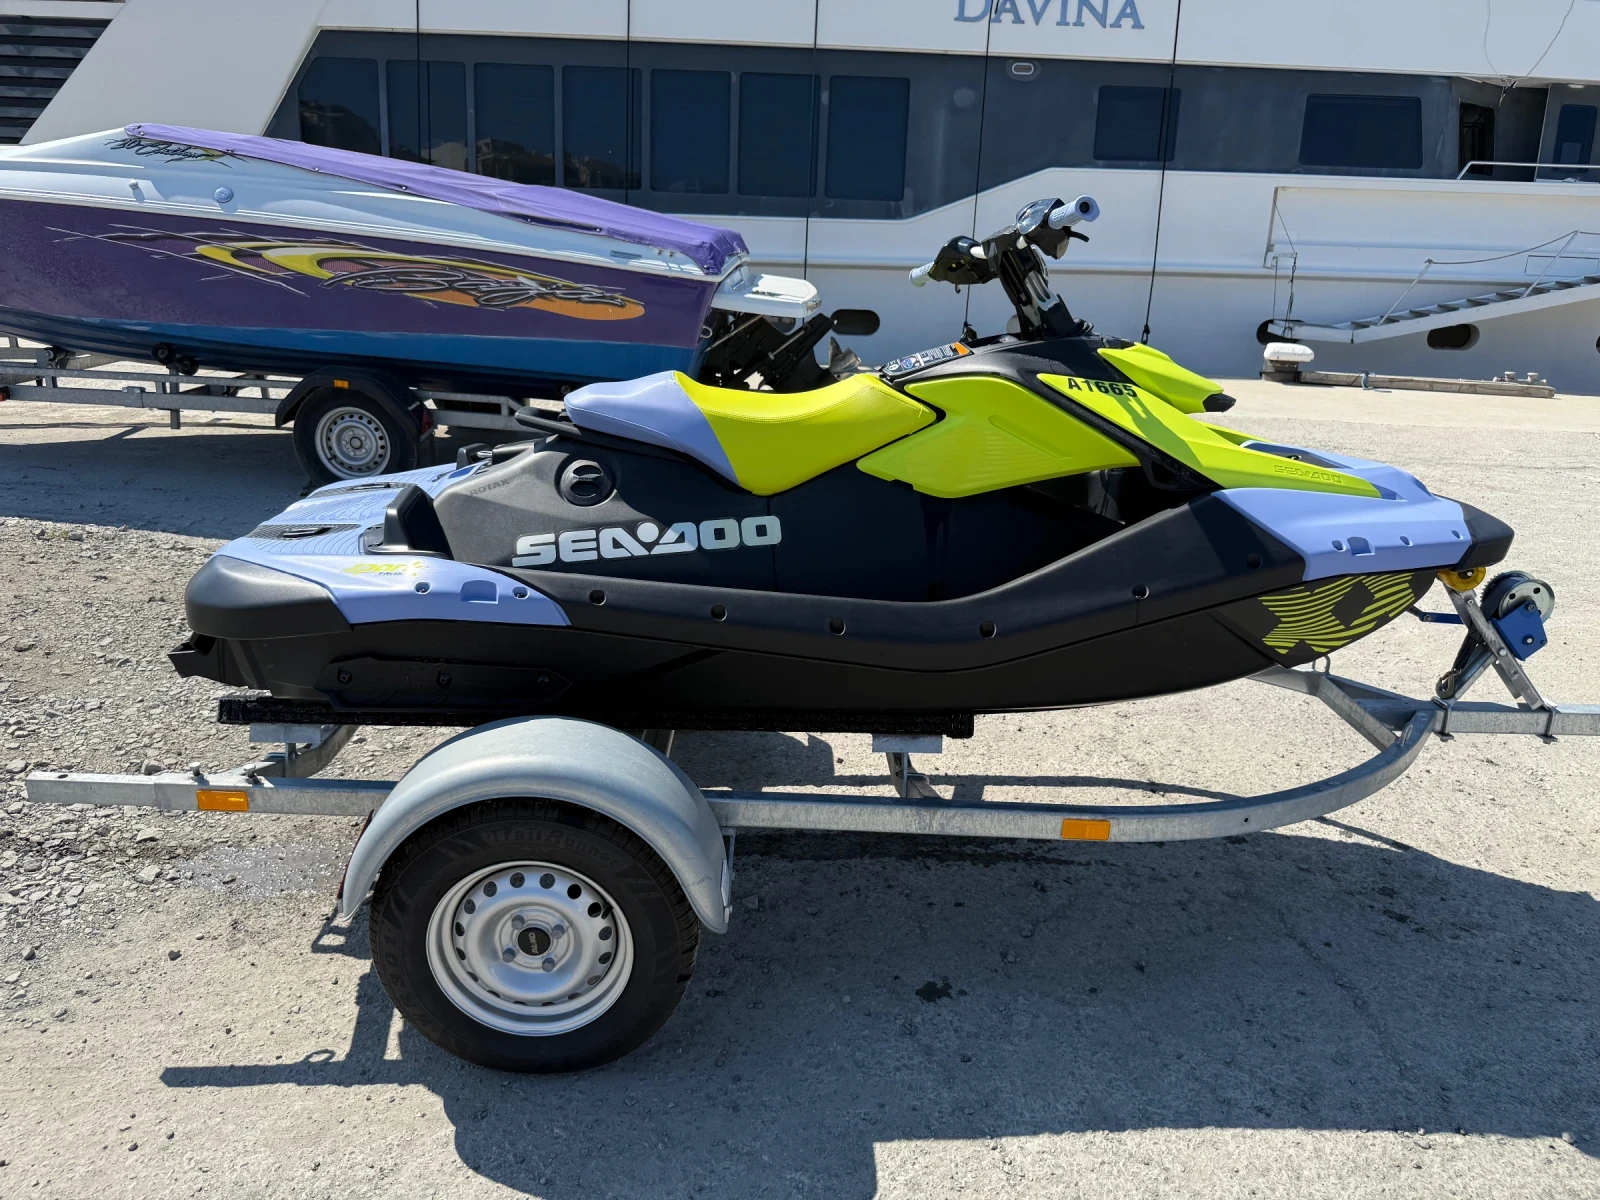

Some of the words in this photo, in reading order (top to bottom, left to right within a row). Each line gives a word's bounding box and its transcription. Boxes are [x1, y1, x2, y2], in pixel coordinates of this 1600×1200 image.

[954, 0, 1145, 29] DAVINA
[1067, 377, 1138, 398] A1665
[469, 479, 509, 497] ROTAX
